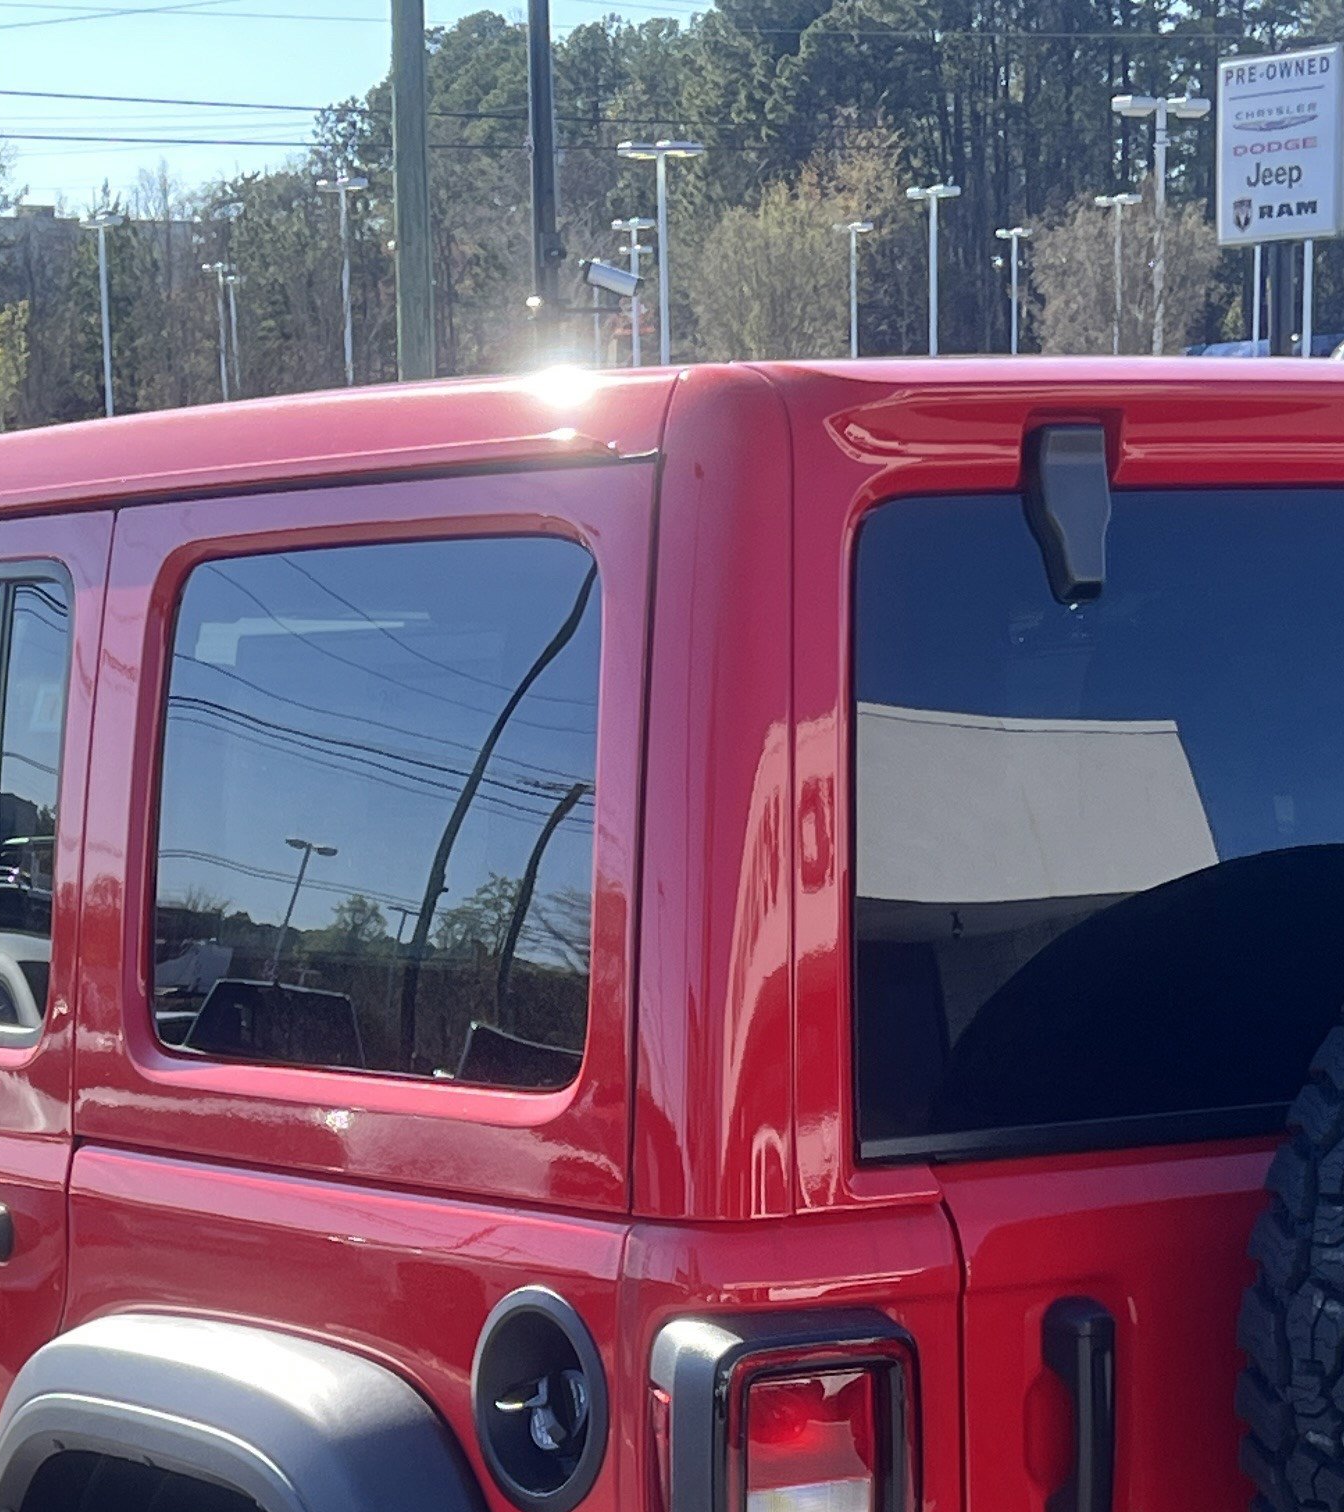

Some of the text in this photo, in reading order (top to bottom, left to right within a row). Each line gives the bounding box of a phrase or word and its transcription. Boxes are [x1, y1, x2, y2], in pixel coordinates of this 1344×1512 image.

[1224, 56, 1331, 87] PRE-OWNED
[1235, 102, 1318, 121] CHRYSLER
[1233, 136, 1318, 157] DODGE
[1246, 162, 1303, 189] Jeep
[1258, 200, 1318, 219] RAM
